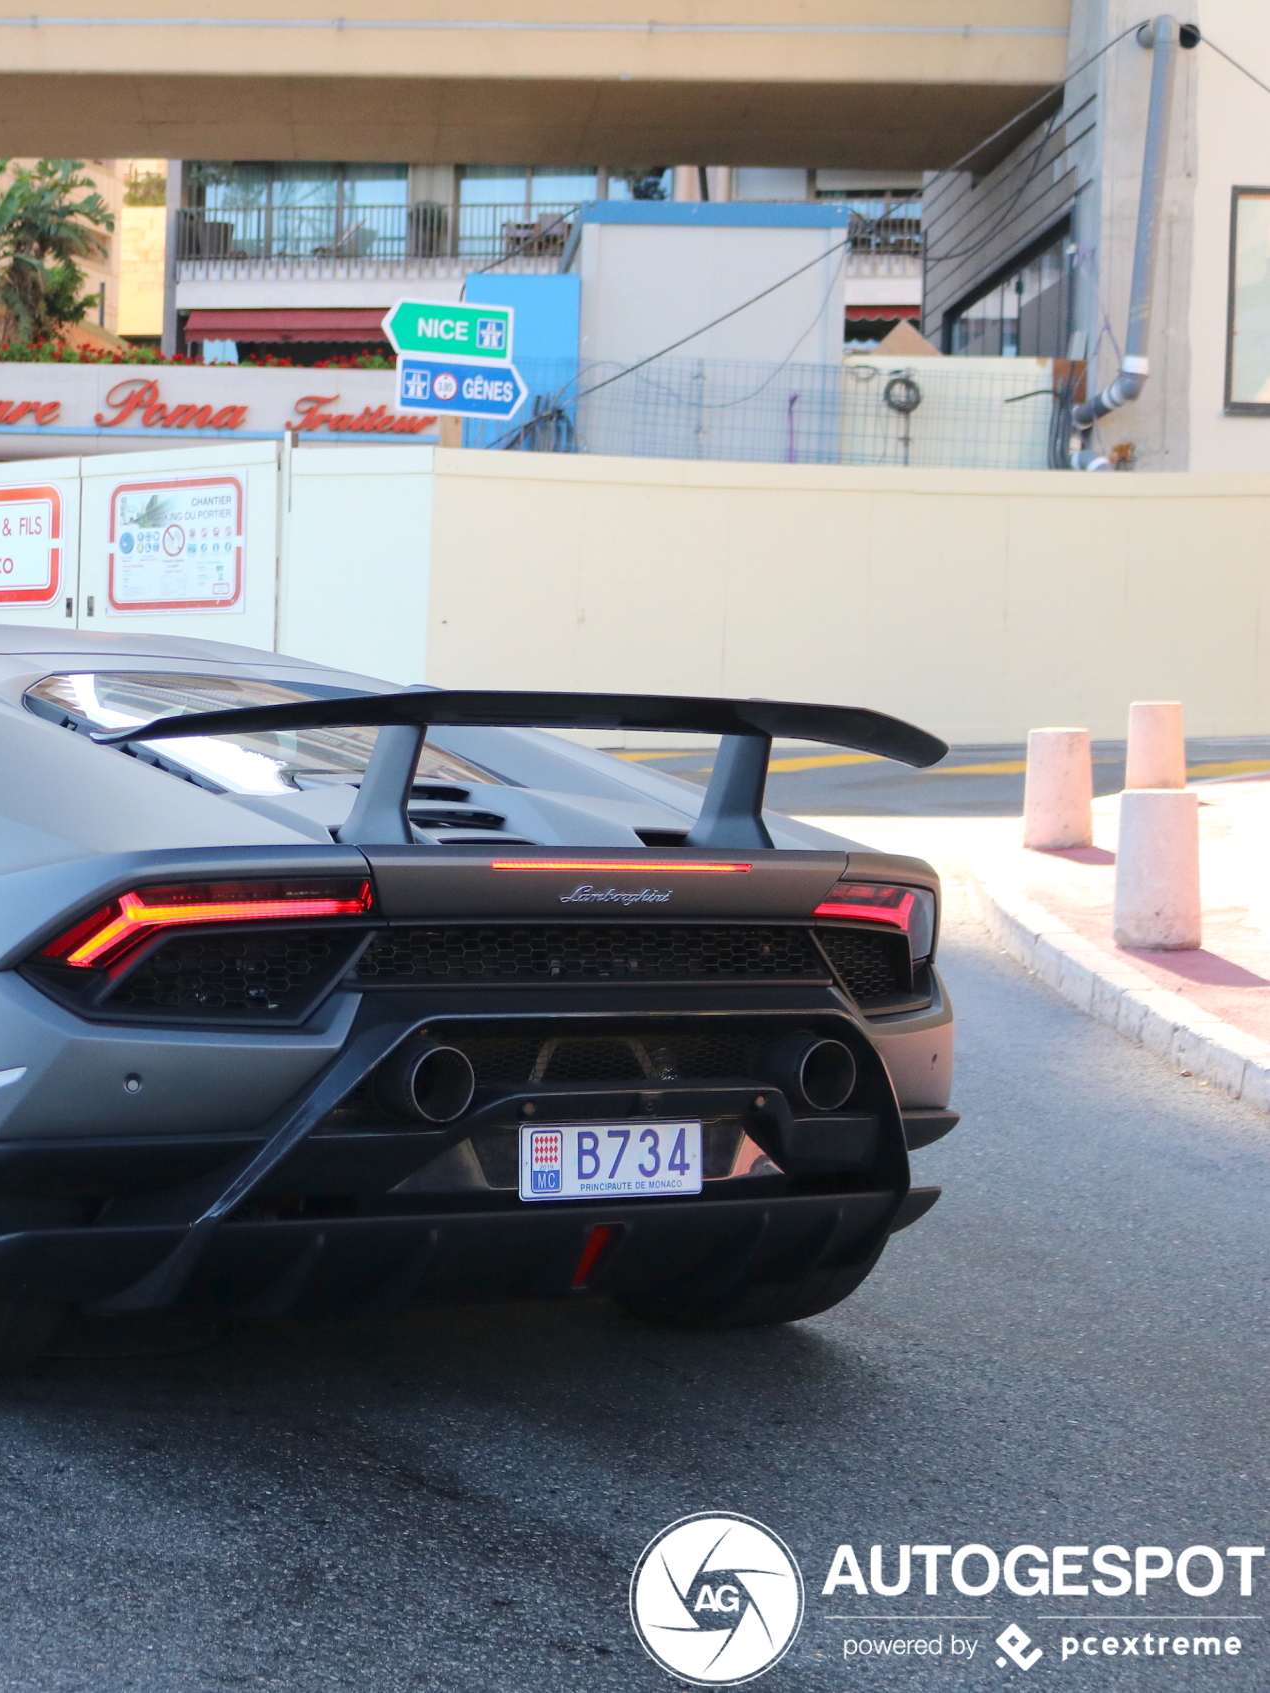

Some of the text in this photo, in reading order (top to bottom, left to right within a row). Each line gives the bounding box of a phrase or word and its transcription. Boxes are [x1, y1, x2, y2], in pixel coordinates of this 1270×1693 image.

[417, 317, 470, 341] NICE
[462, 375, 514, 403] GÊNES
[94, 378, 248, 429] Poma
[285, 394, 438, 434] Traiteur
[191, 496, 232, 507] CHANTIER
[185, 510, 196, 521] DU
[197, 508, 232, 520] PORTIER
[2, 517, 12, 536] &
[19, 516, 43, 536] FILS
[559, 884, 673, 906] Lamborghini
[577, 1128, 690, 1180] B734
[537, 1172, 556, 1189] MC
[580, 1179, 682, 1192] PRINCIPAUTE DE MONACO
